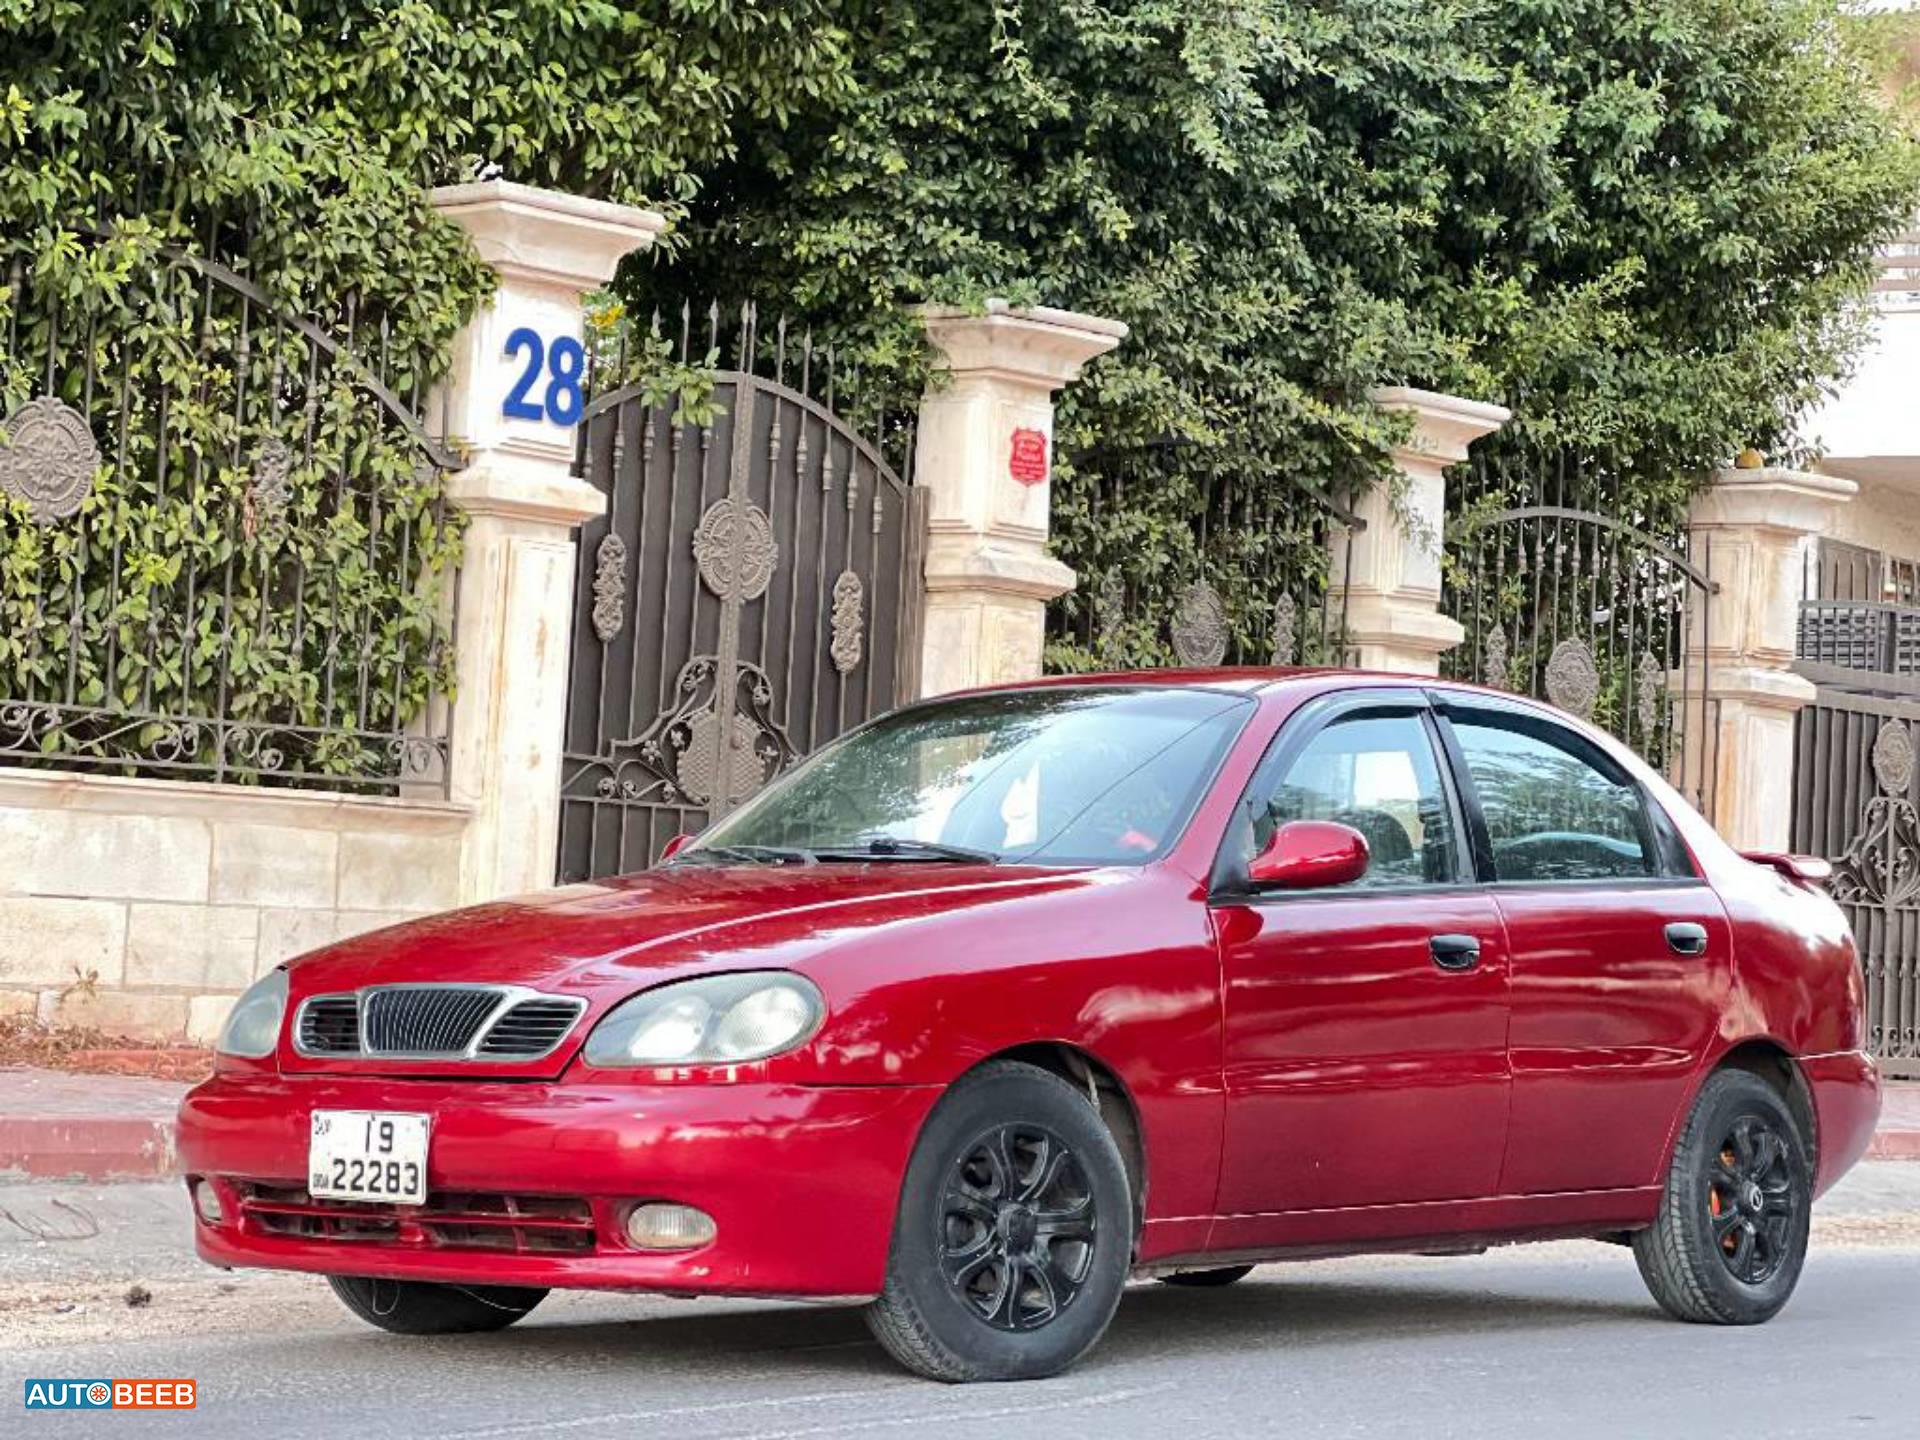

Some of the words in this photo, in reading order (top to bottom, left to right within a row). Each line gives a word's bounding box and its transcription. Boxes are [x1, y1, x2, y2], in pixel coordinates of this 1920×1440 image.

[502, 327, 584, 426] 28
[365, 1120, 394, 1153] 19
[332, 1158, 419, 1195] 22283
